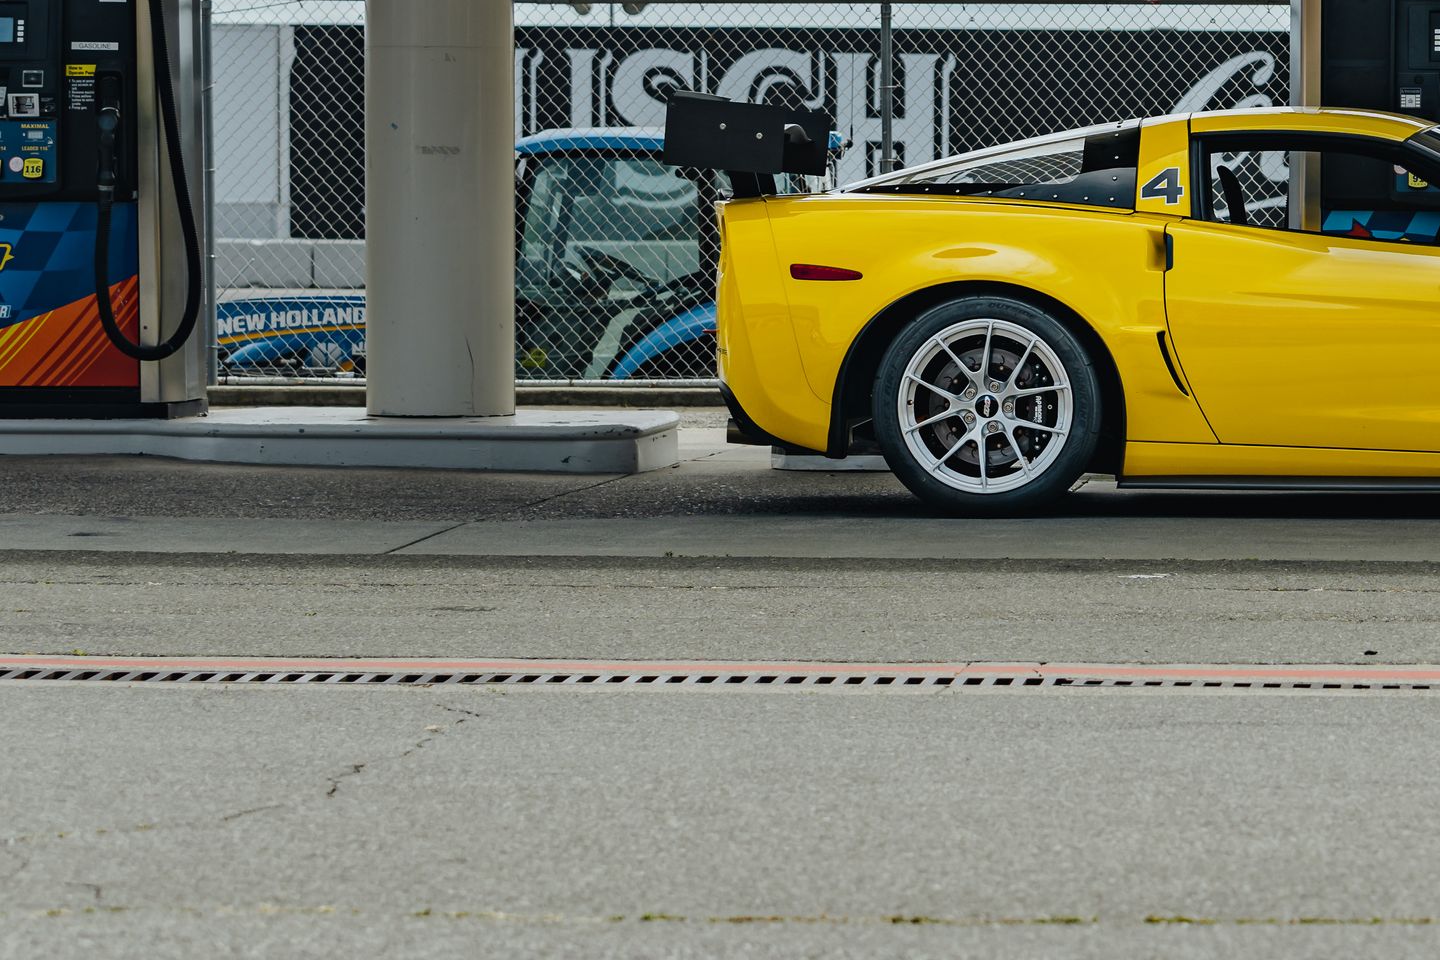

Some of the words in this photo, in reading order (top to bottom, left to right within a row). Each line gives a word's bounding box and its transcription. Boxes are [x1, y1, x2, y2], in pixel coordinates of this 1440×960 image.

[25, 165, 41, 174] 116
[1140, 167, 1184, 205] 4
[217, 313, 266, 335] NEW
[271, 307, 366, 329] HOLLAND
